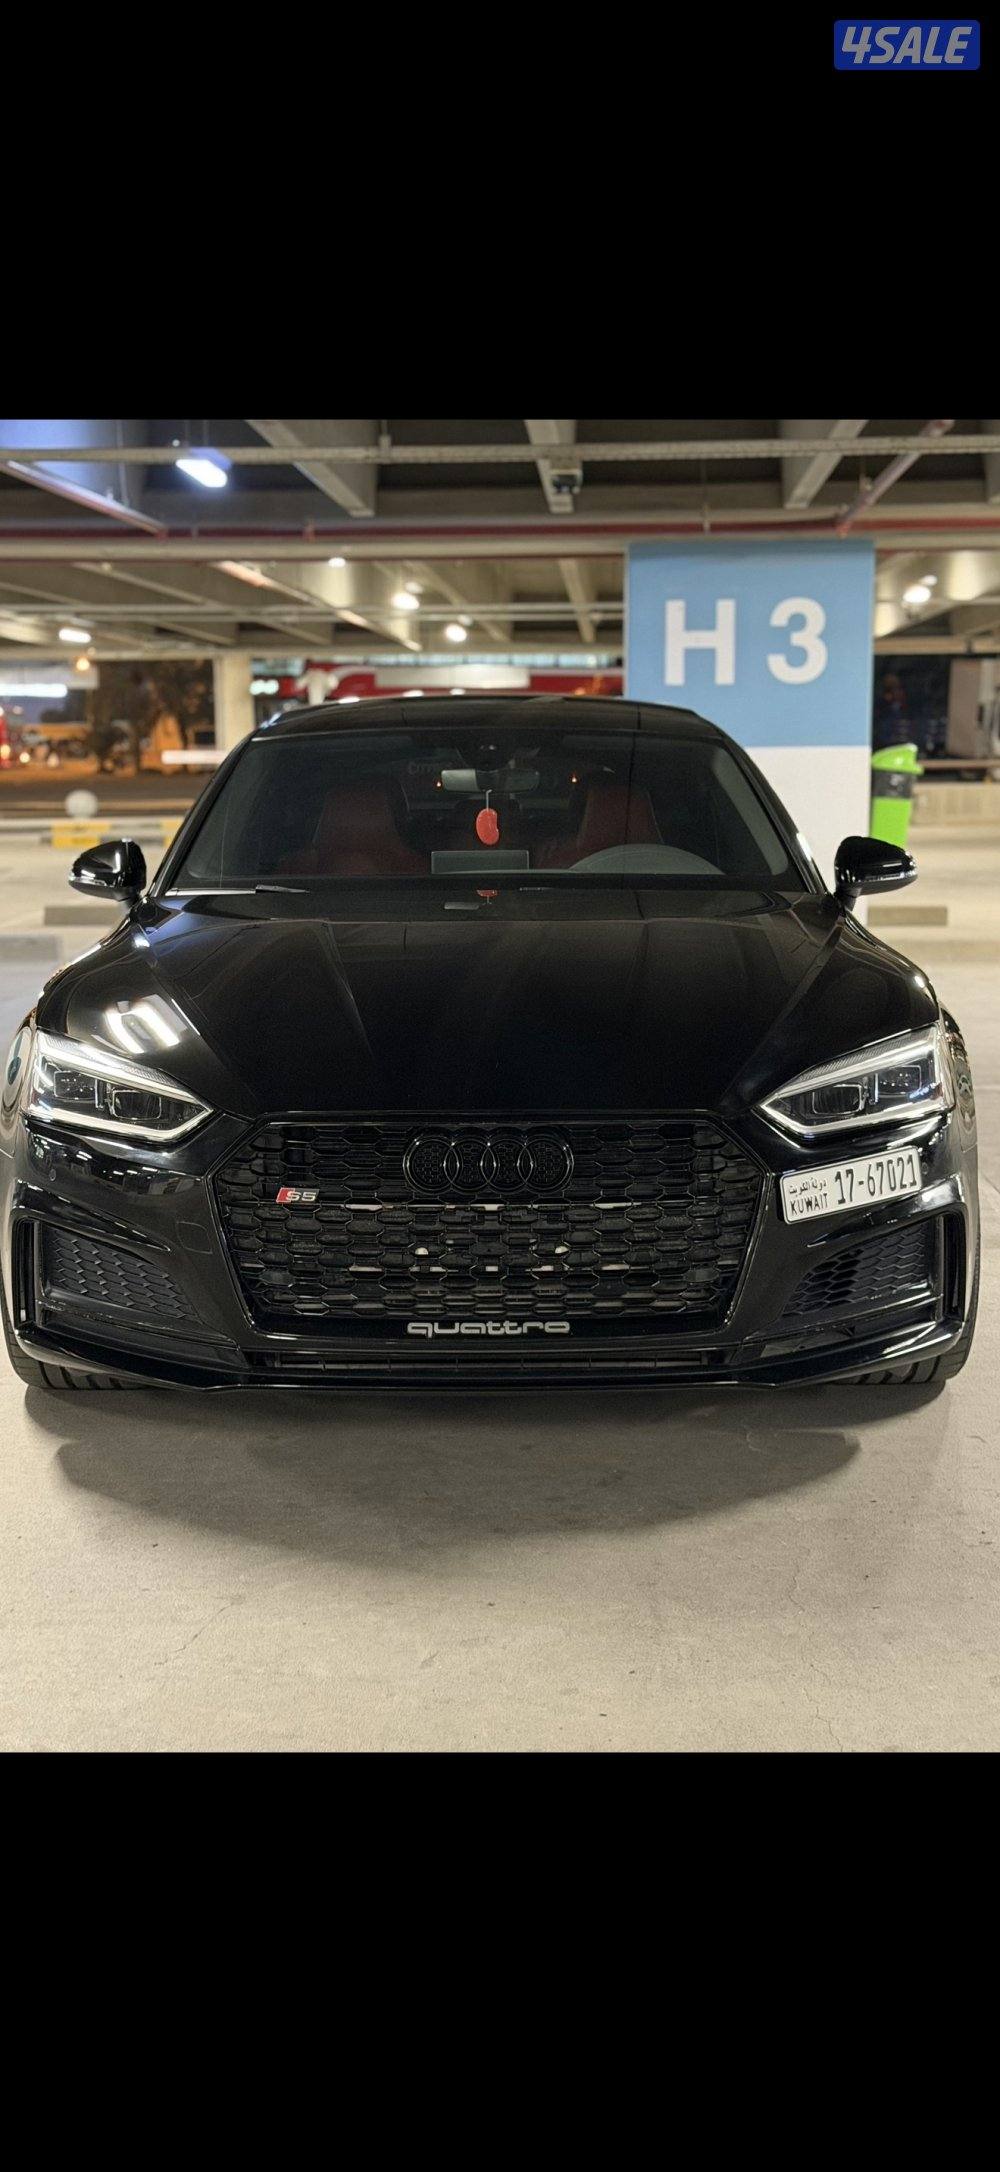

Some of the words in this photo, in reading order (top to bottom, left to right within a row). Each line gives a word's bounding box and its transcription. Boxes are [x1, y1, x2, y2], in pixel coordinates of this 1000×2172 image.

[834, 1154, 917, 1204] 17-67021
[286, 1190, 316, 1201] S5
[790, 1193, 828, 1215] KUWAIT
[407, 1320, 570, 1338] quattro
